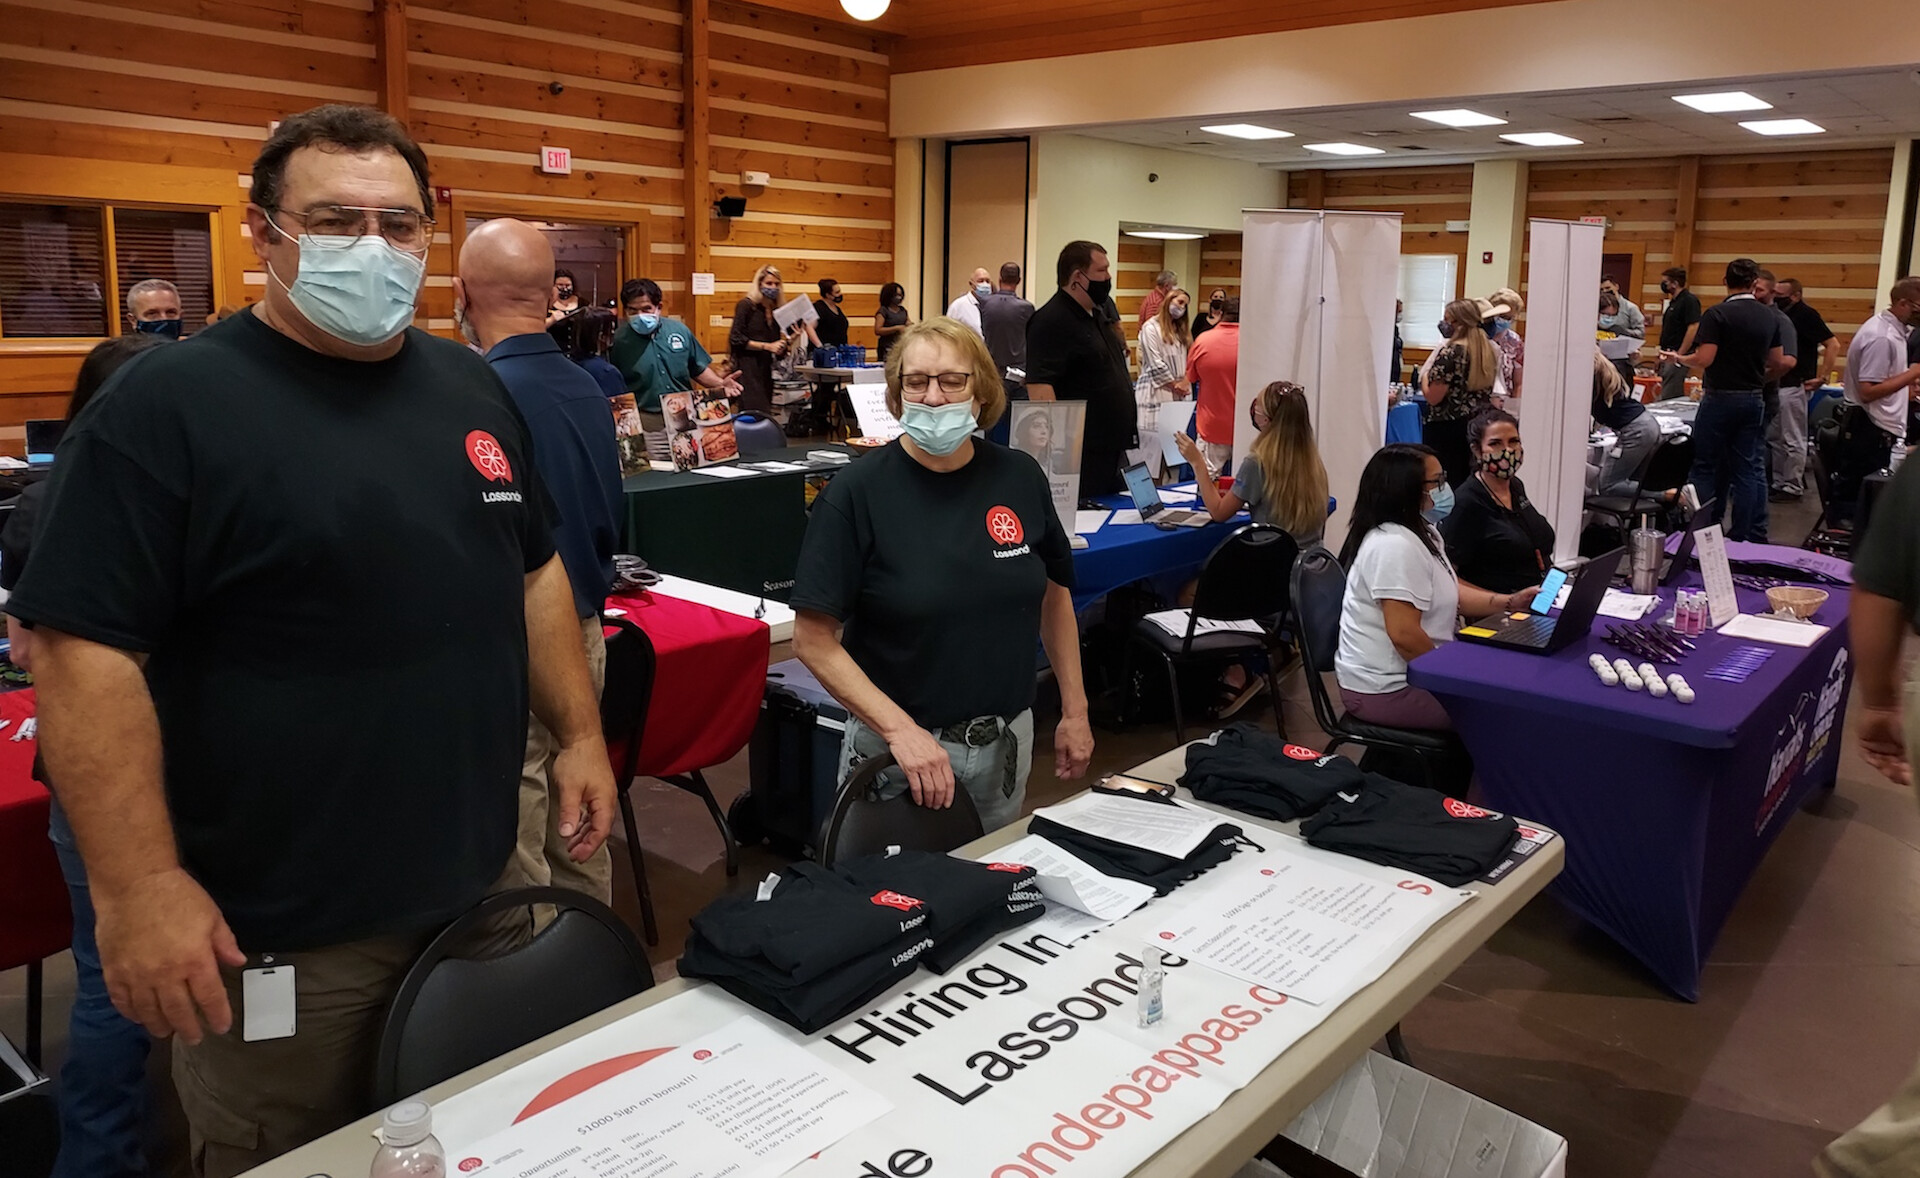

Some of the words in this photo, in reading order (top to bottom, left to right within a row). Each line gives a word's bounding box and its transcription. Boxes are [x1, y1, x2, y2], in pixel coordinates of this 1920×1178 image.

[548, 151, 566, 169] EXIT
[823, 963, 1028, 1063] Hiring
[577, 1114, 614, 1135] $1000
[613, 1102, 638, 1120] Sign
[639, 1095, 654, 1107] on
